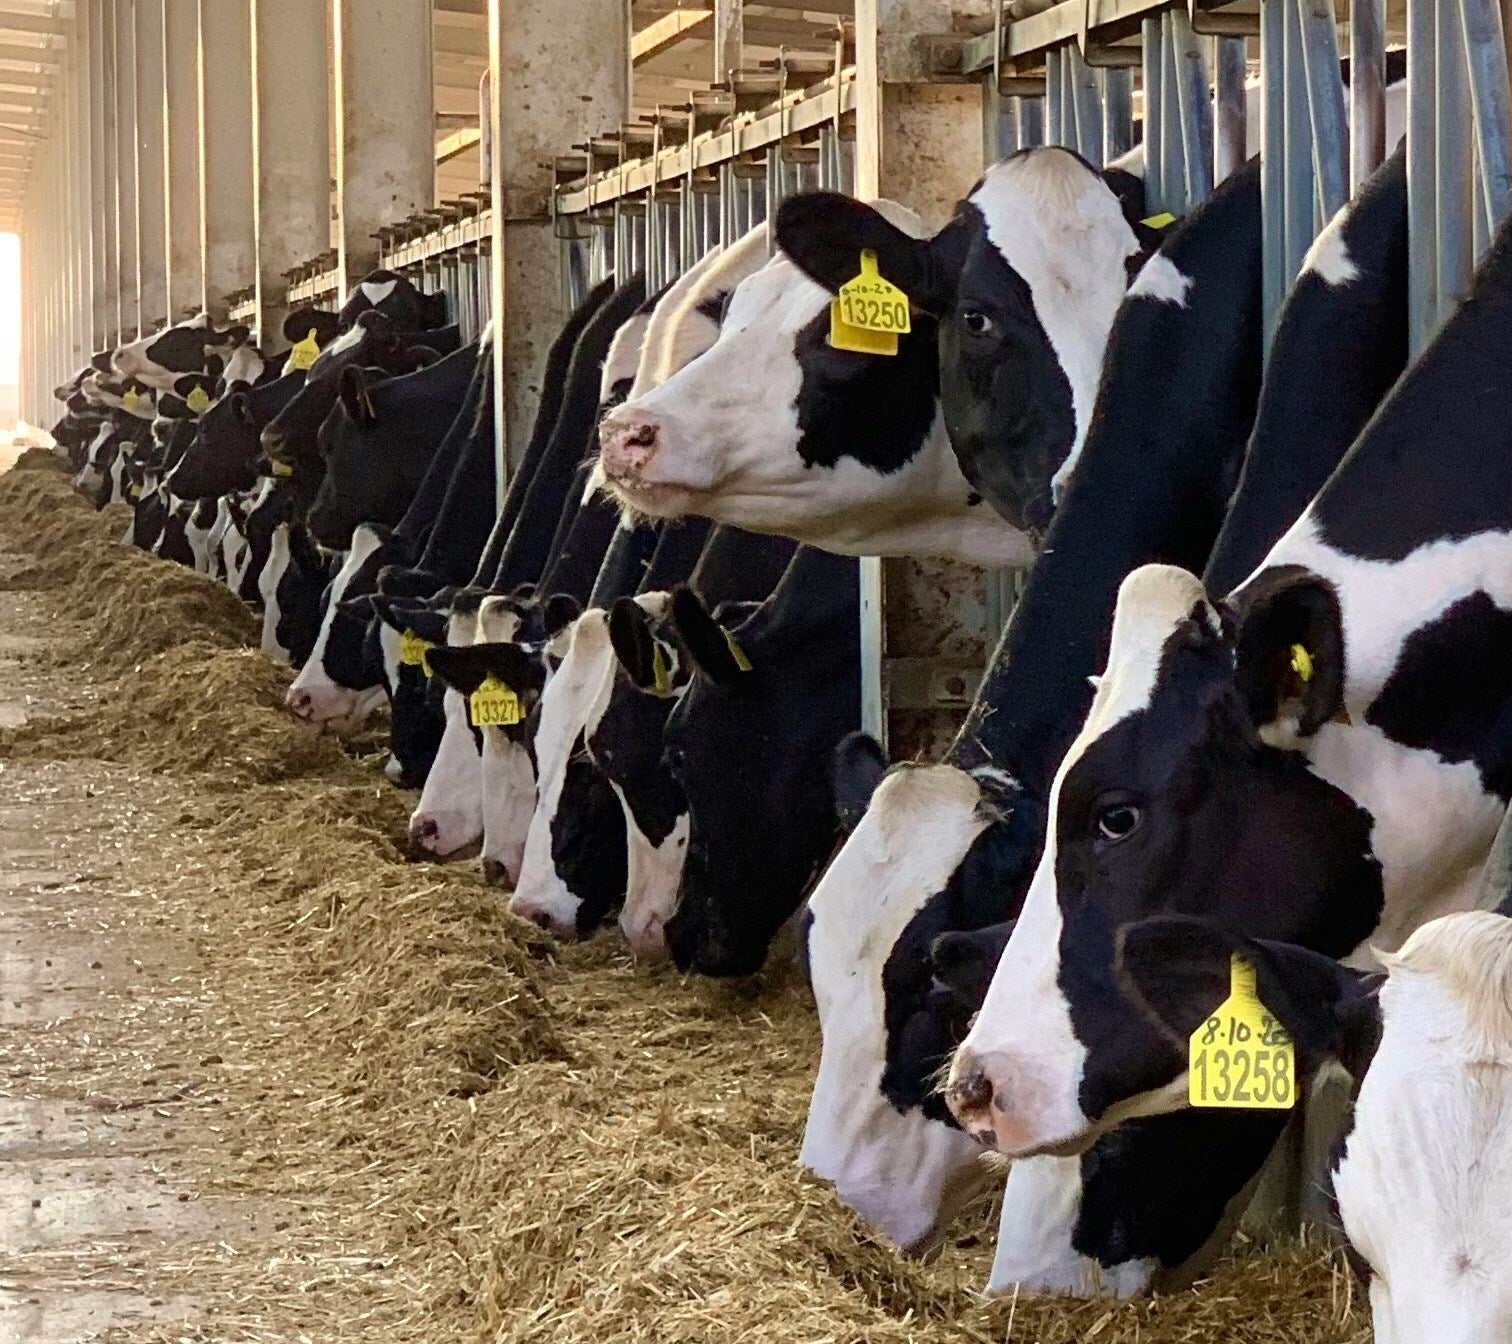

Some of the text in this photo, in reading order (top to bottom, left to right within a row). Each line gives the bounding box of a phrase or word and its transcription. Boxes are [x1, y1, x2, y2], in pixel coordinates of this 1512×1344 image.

[843, 296, 907, 330] 13250
[473, 699, 516, 724] 13327
[1194, 1048, 1290, 1103] 13258
